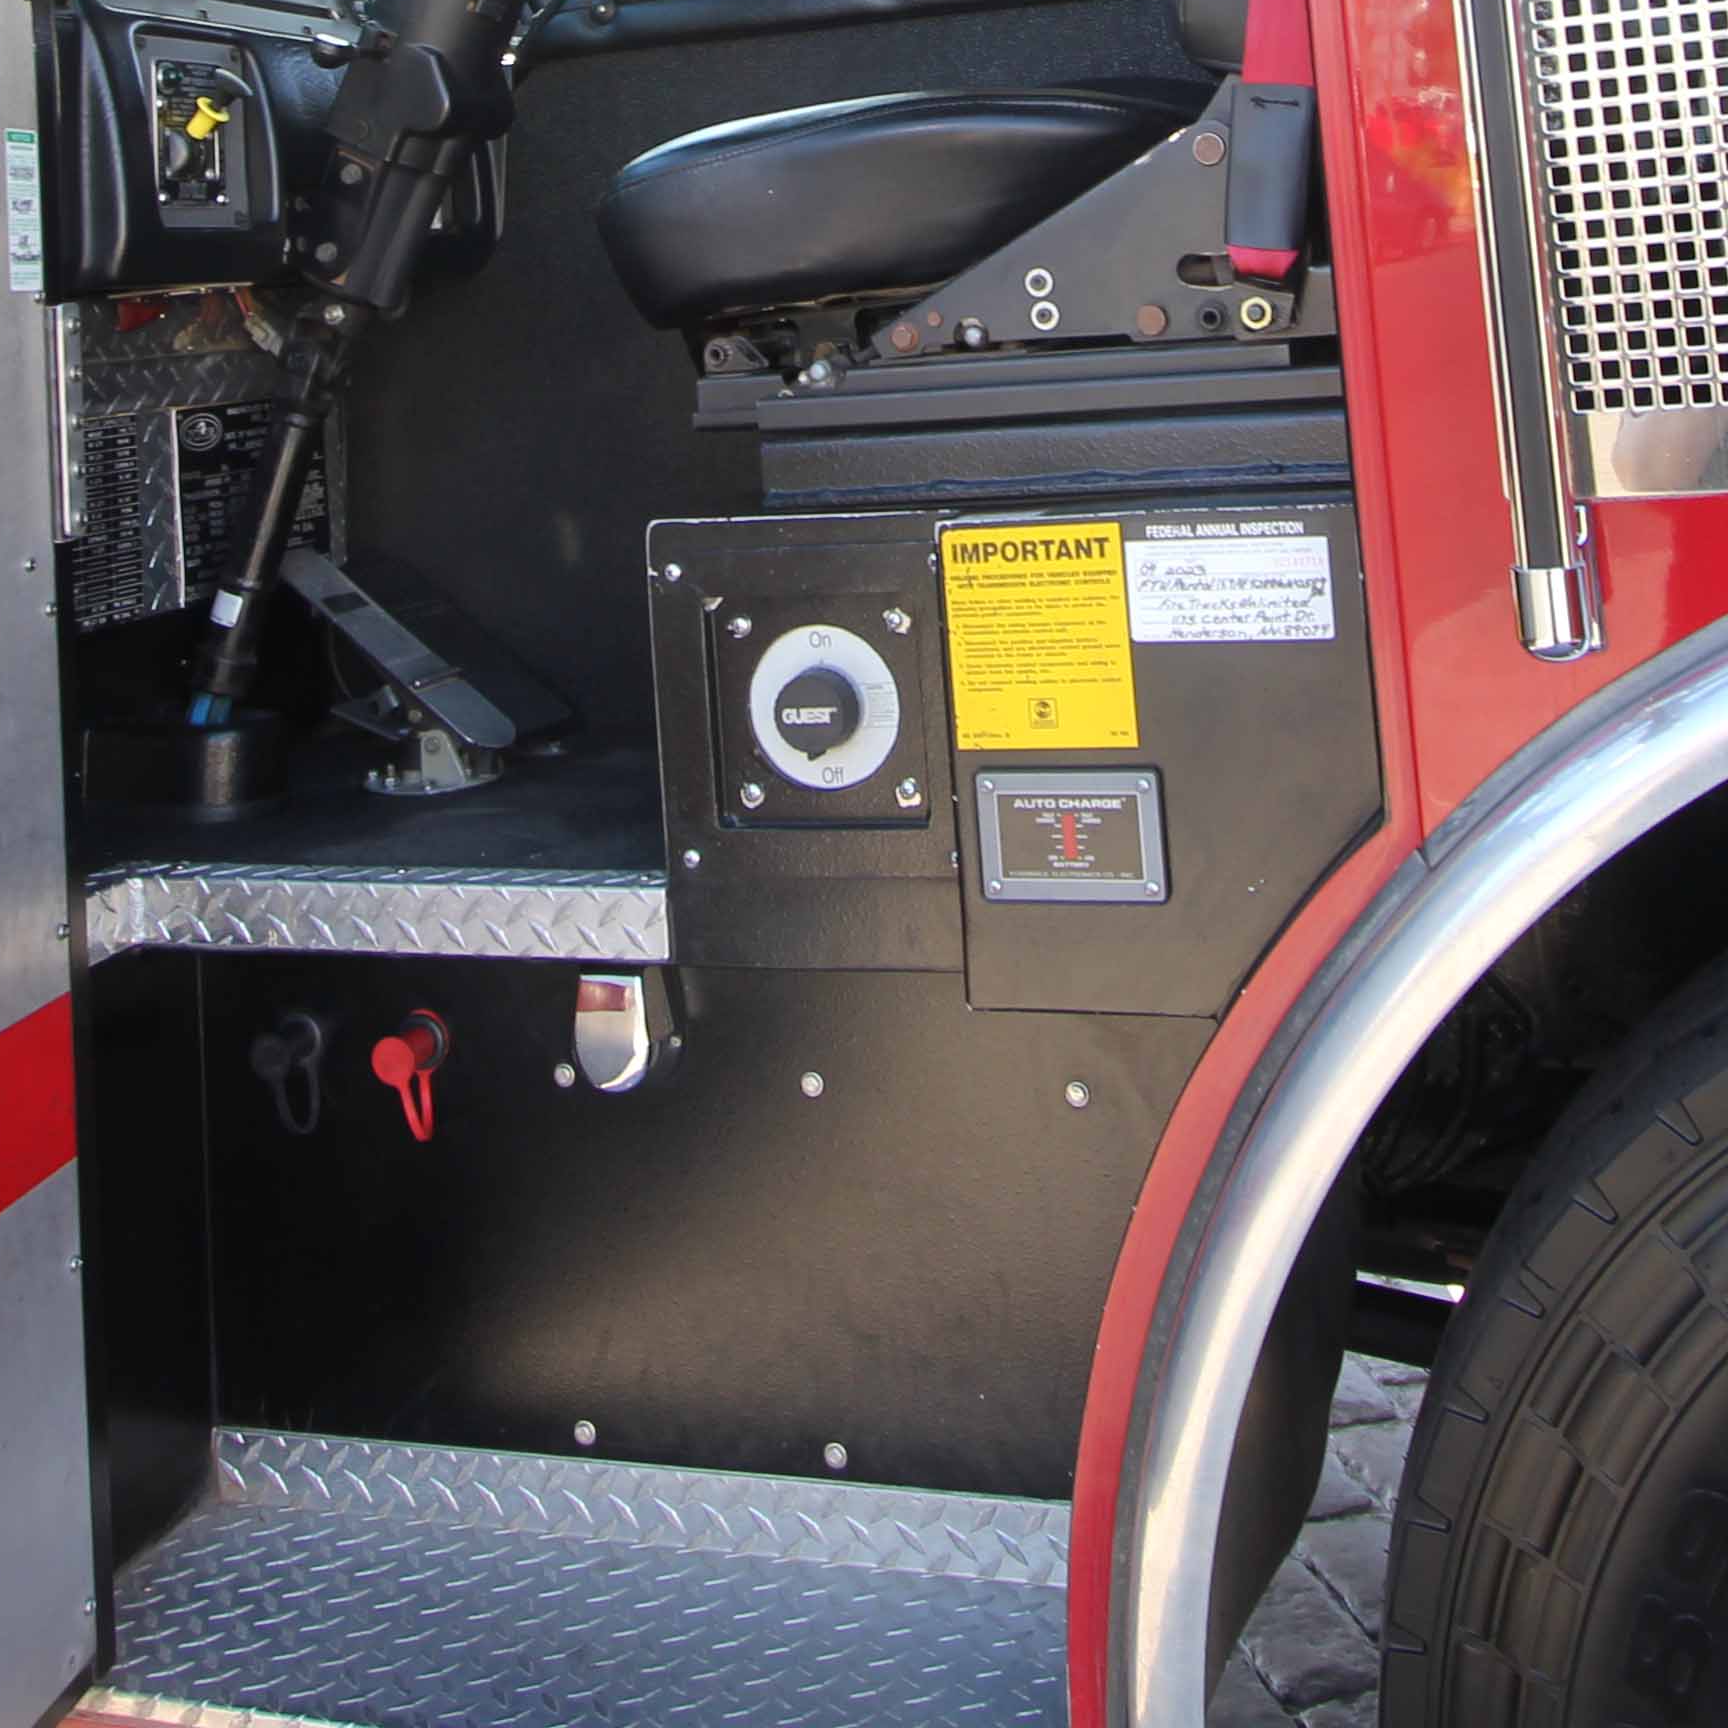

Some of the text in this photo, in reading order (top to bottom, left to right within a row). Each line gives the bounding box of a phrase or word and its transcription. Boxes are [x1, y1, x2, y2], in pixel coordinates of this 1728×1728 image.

[1145, 521, 1305, 539] FEDERAL ANNUAL INSPECTION
[951, 536, 1110, 565] IMPORTANT
[808, 631, 832, 648] On
[781, 707, 834, 725] GUEST
[822, 766, 845, 784] Off
[1013, 798, 1122, 810] AUTO CHARGE
